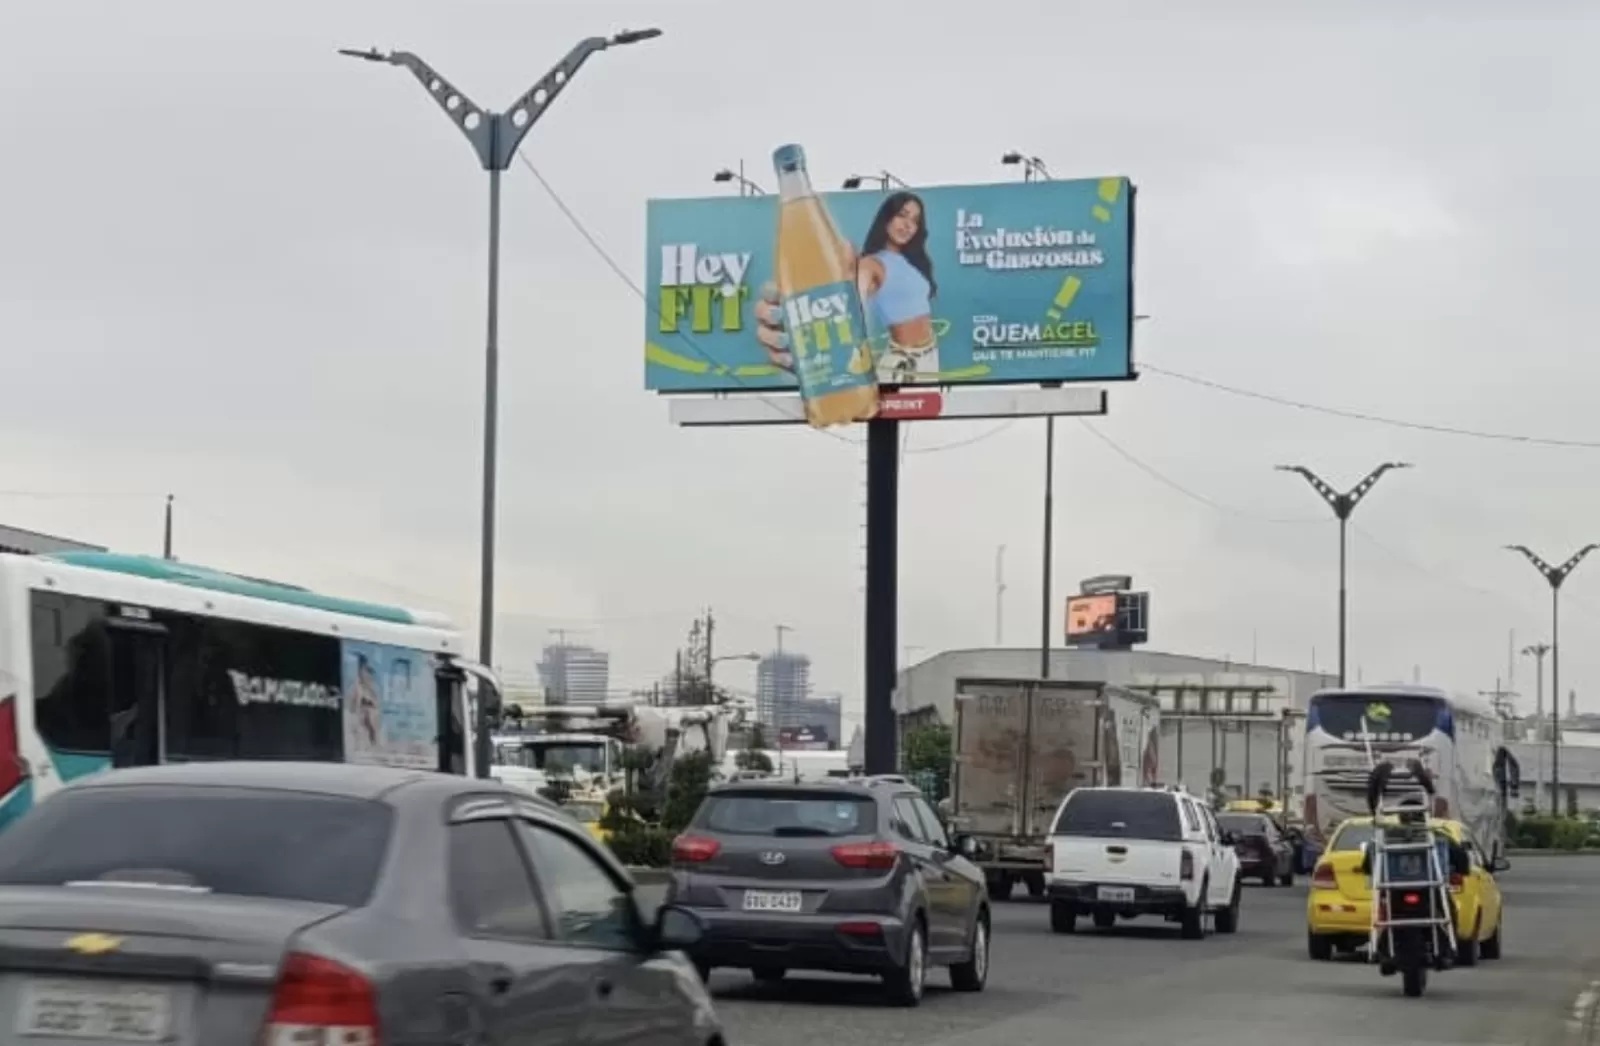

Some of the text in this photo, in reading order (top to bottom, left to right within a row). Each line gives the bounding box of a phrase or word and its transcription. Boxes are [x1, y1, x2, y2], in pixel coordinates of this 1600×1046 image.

[957, 208, 983, 228] La
[956, 226, 1074, 250] Evolución
[660, 243, 751, 297] Hey
[985, 249, 1104, 269] Gaseosas
[659, 284, 749, 333] FIT
[785, 292, 850, 327] Hey
[793, 314, 855, 359] FIT
[972, 321, 1098, 347] QUEMACEL
